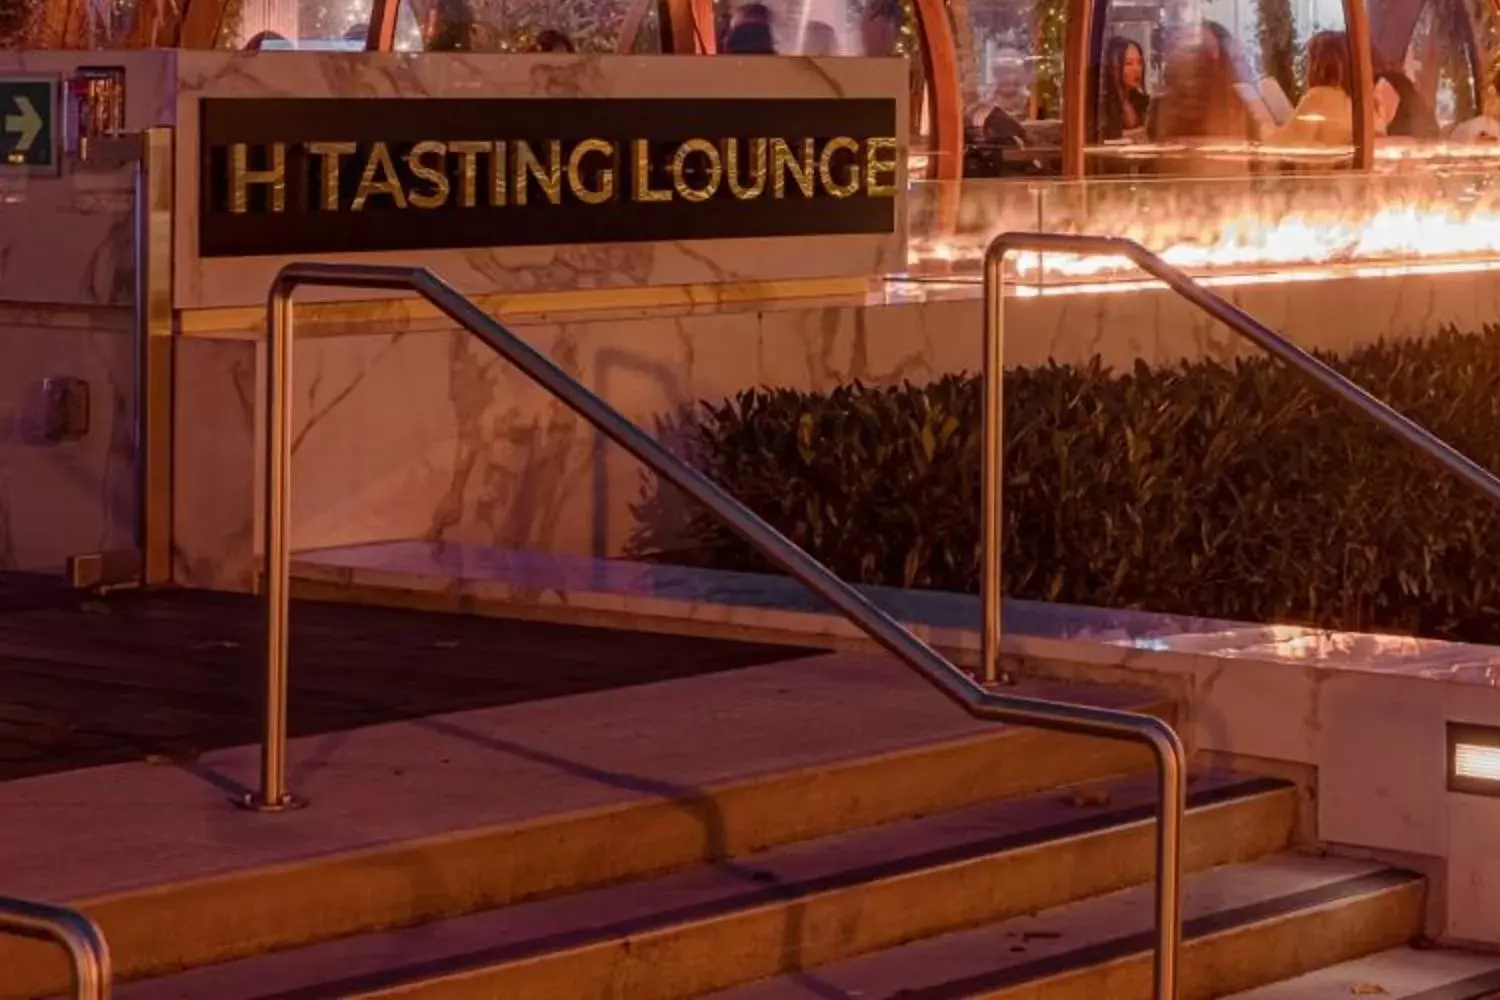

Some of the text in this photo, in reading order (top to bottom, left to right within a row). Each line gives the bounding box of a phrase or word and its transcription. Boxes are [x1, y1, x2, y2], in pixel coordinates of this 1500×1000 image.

[229, 136, 898, 213] H TASTING LOUNGE
